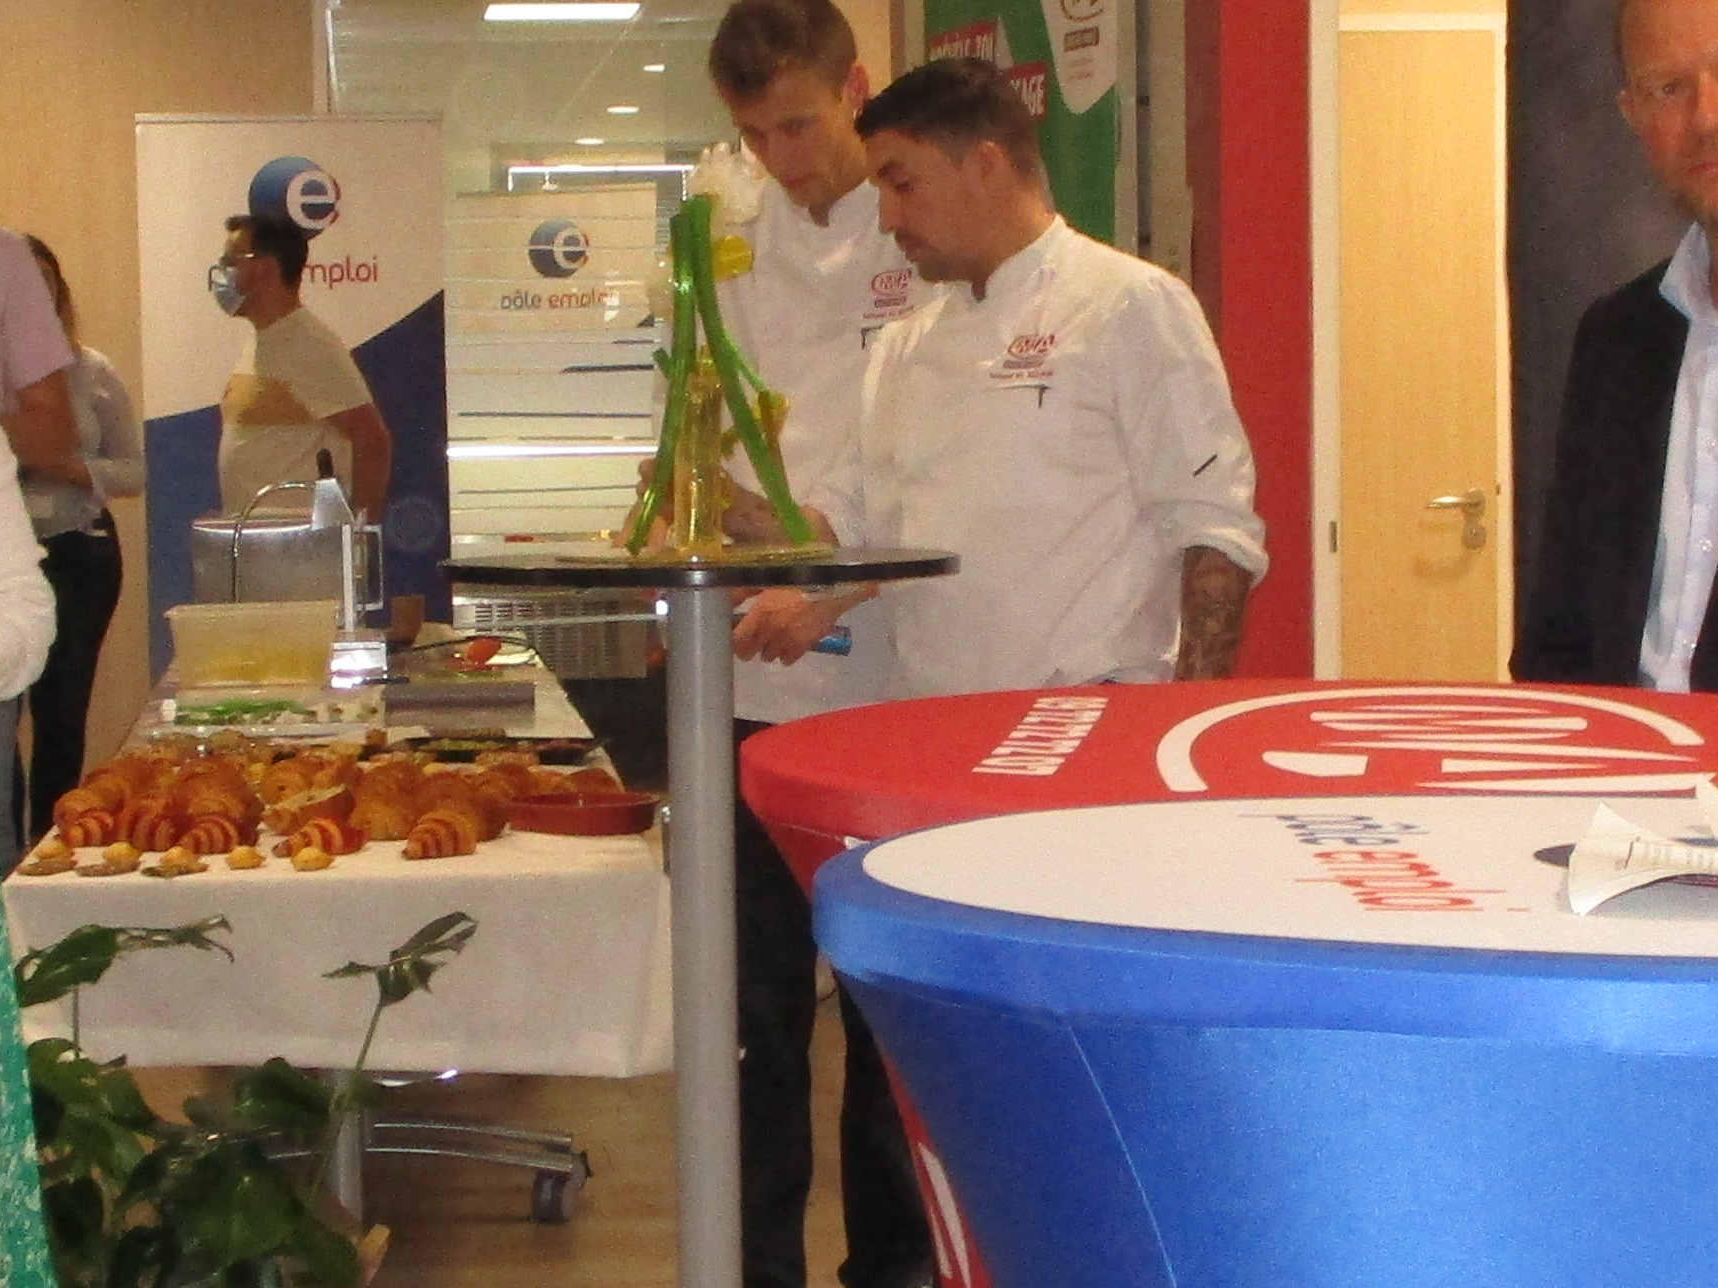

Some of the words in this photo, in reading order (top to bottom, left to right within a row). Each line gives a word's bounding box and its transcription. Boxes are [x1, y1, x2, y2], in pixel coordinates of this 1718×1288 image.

[303, 255, 378, 290] mploi
[1236, 813, 1431, 845] pôle
[1295, 849, 1530, 912] emploi
